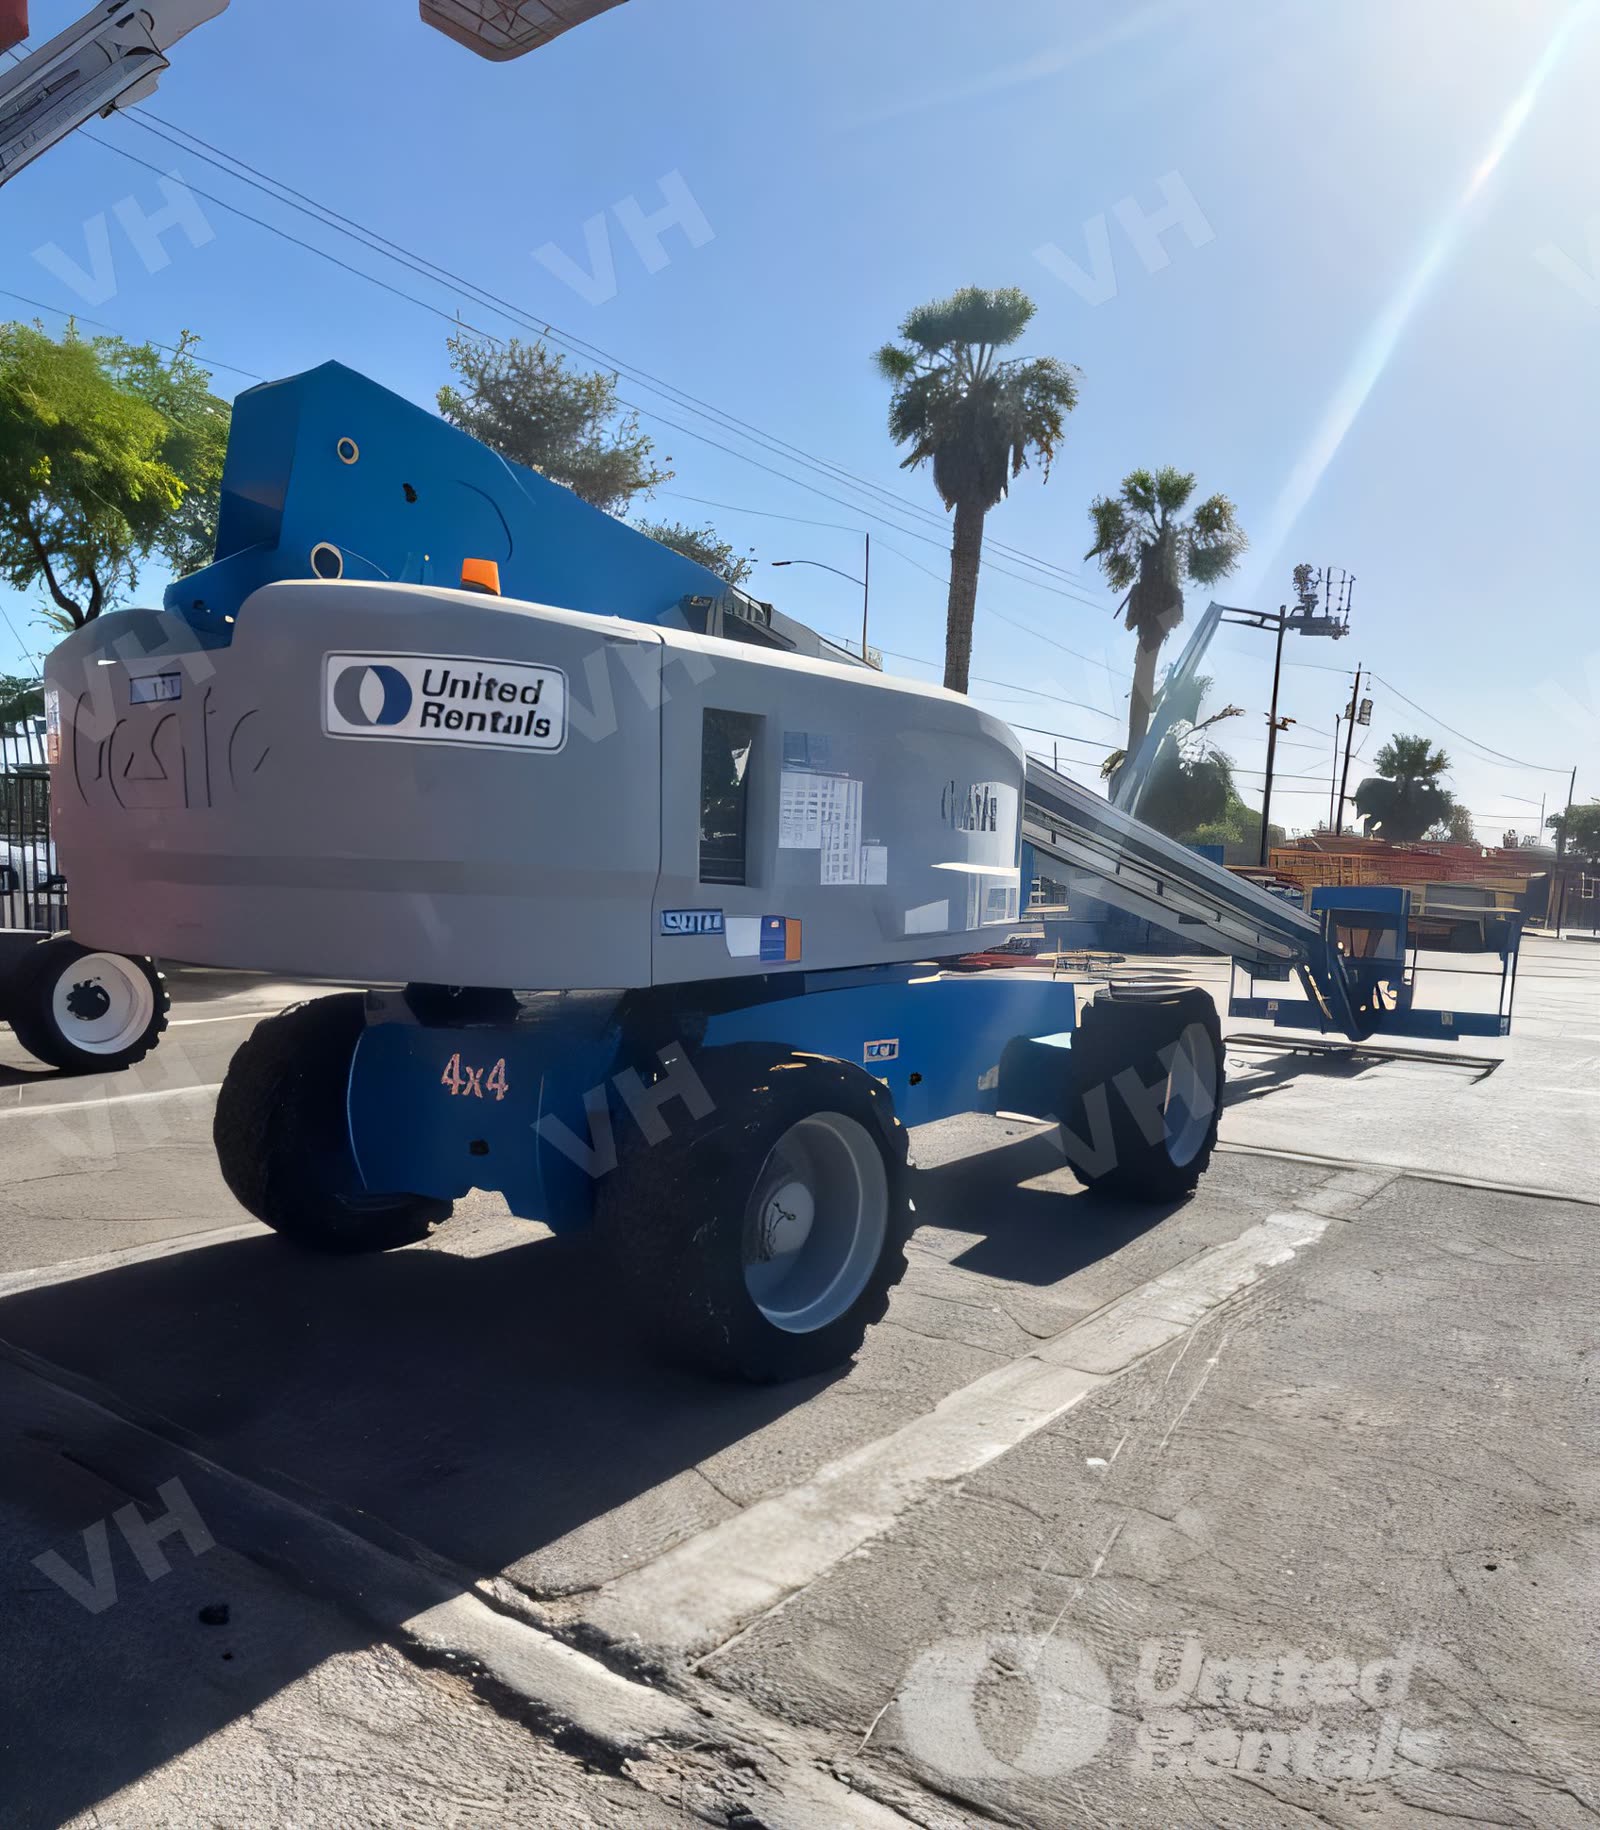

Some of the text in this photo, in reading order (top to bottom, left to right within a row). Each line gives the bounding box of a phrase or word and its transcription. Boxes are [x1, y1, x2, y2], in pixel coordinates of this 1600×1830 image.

[422, 669, 544, 705] United
[420, 701, 550, 738] Rentals
[441, 1053, 508, 1101] 4x4
